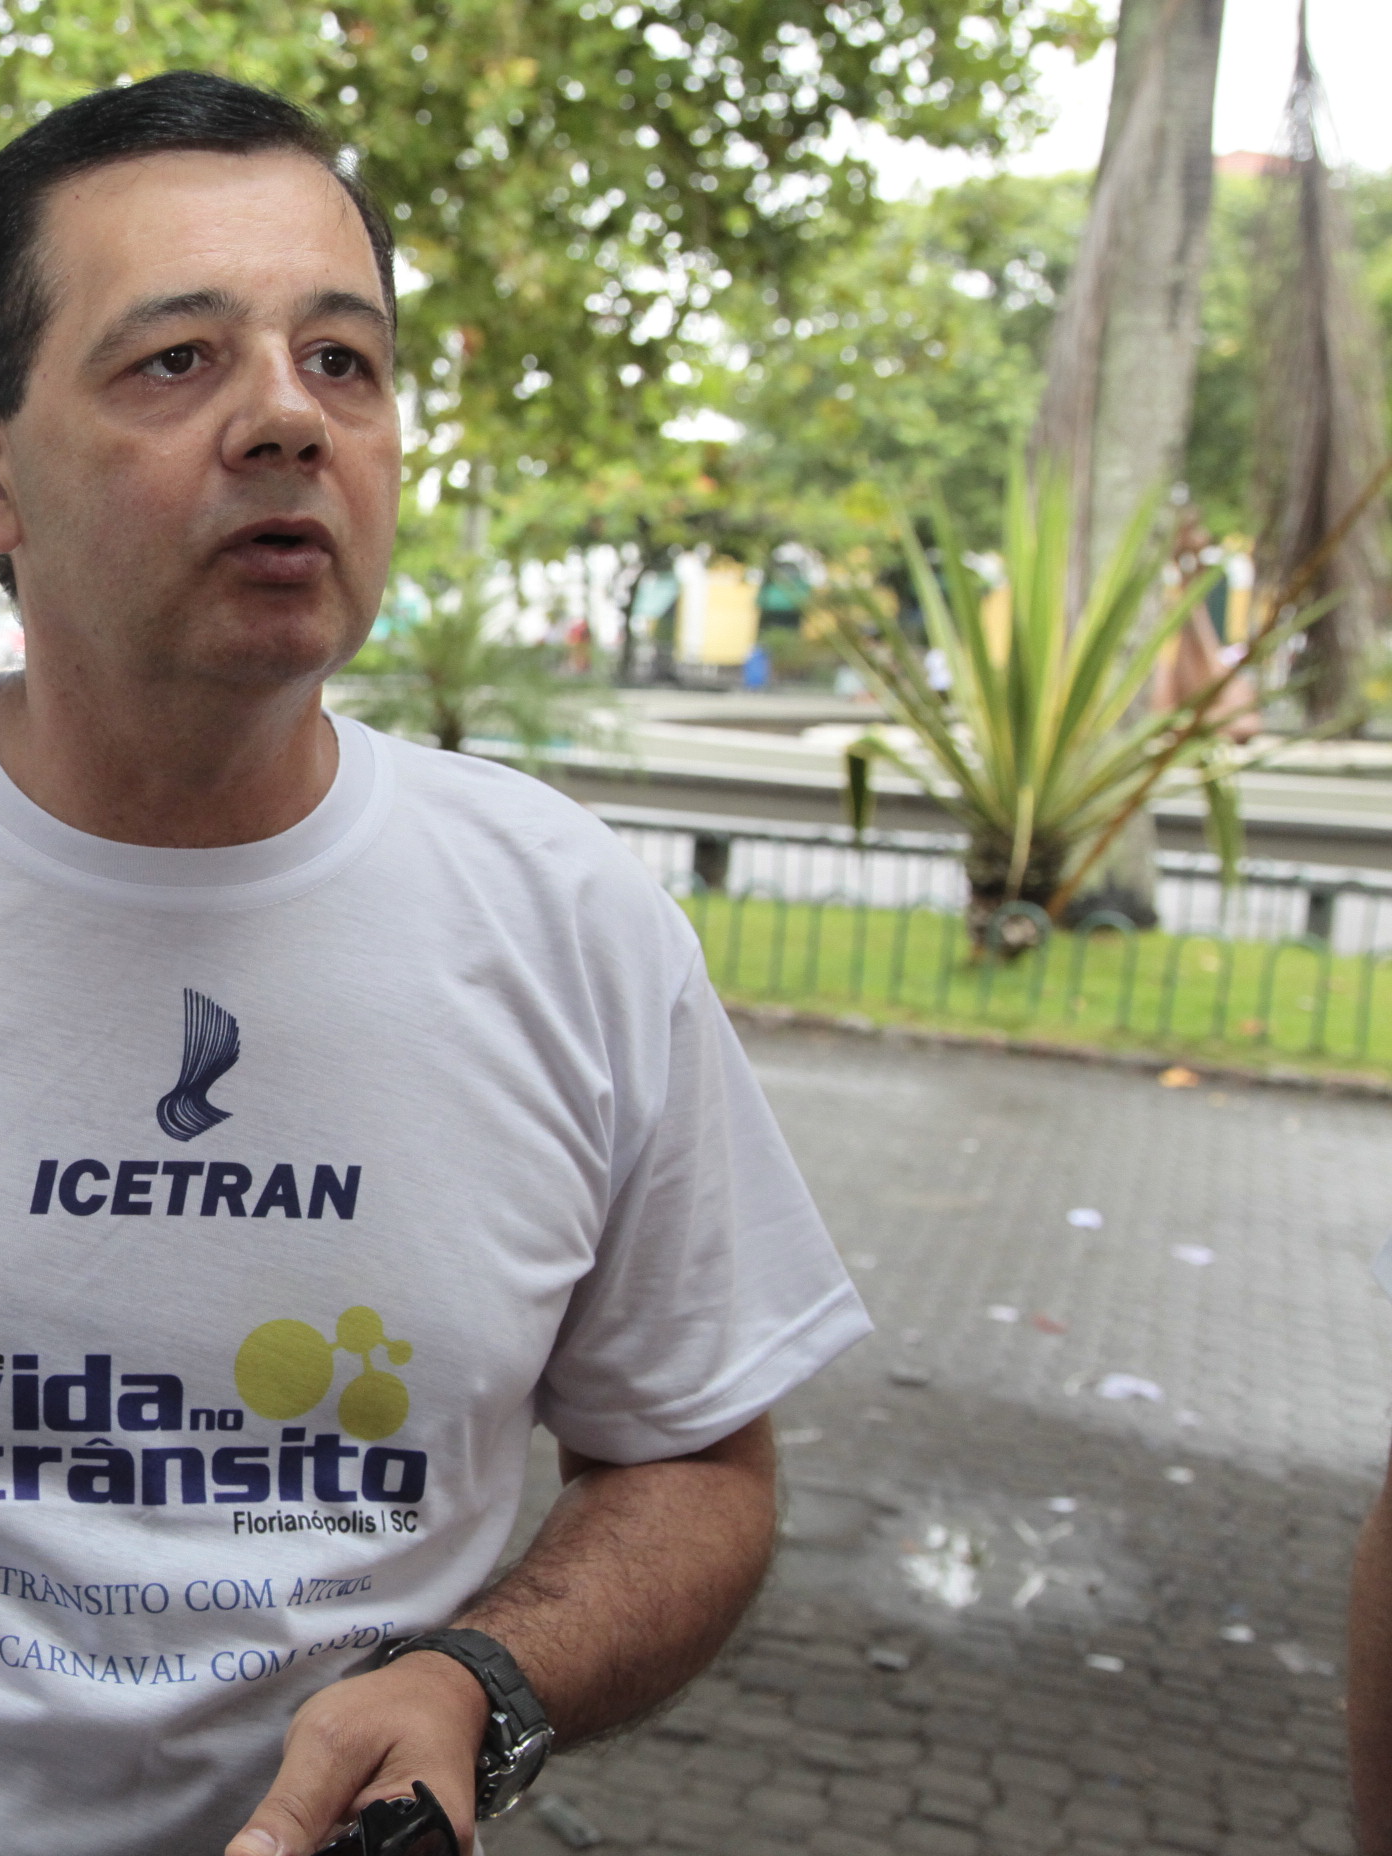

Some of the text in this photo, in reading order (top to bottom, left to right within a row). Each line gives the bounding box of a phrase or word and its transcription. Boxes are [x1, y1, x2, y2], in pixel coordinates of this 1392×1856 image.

[30, 1158, 362, 1220] ICETRAN
[190, 1406, 244, 1431] no
[233, 1510, 376, 1536] Florianópolis
[390, 1510, 418, 1533] SC
[185, 1579, 275, 1611] COM
[211, 1649, 298, 1682] COM
